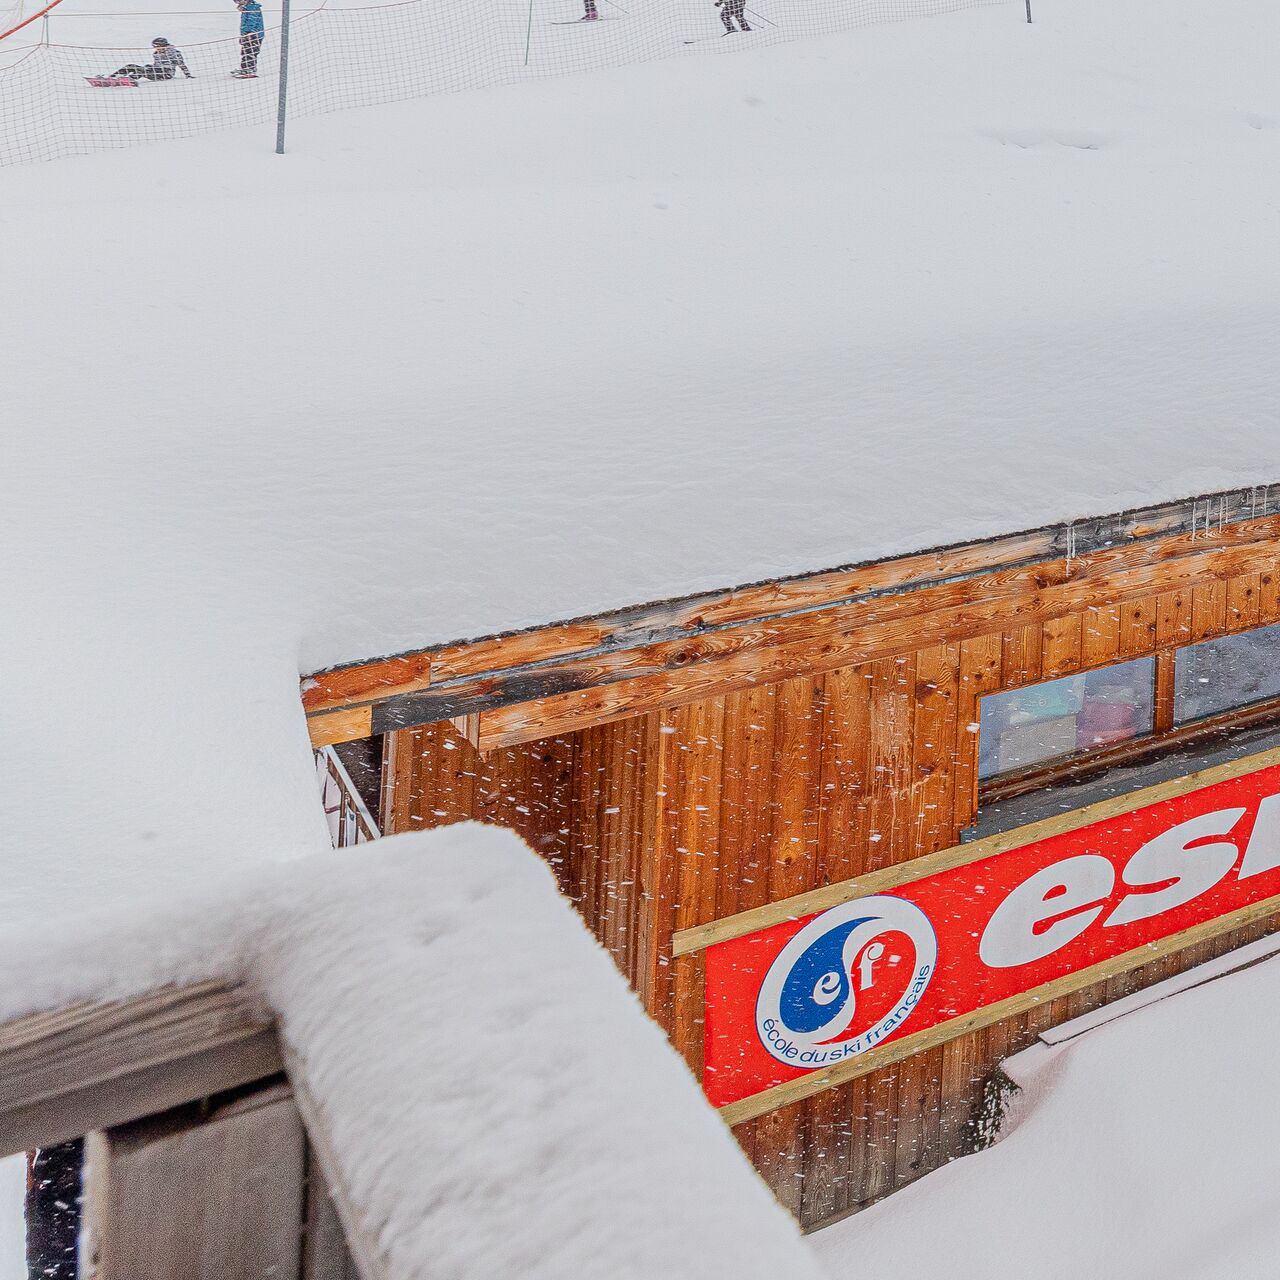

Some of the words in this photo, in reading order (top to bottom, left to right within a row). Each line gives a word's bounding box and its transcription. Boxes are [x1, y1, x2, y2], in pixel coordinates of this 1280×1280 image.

[763, 1018, 800, 1059] école
[799, 1050, 827, 1063] du
[829, 1039, 862, 1062] ski
[864, 964, 931, 1045] français
